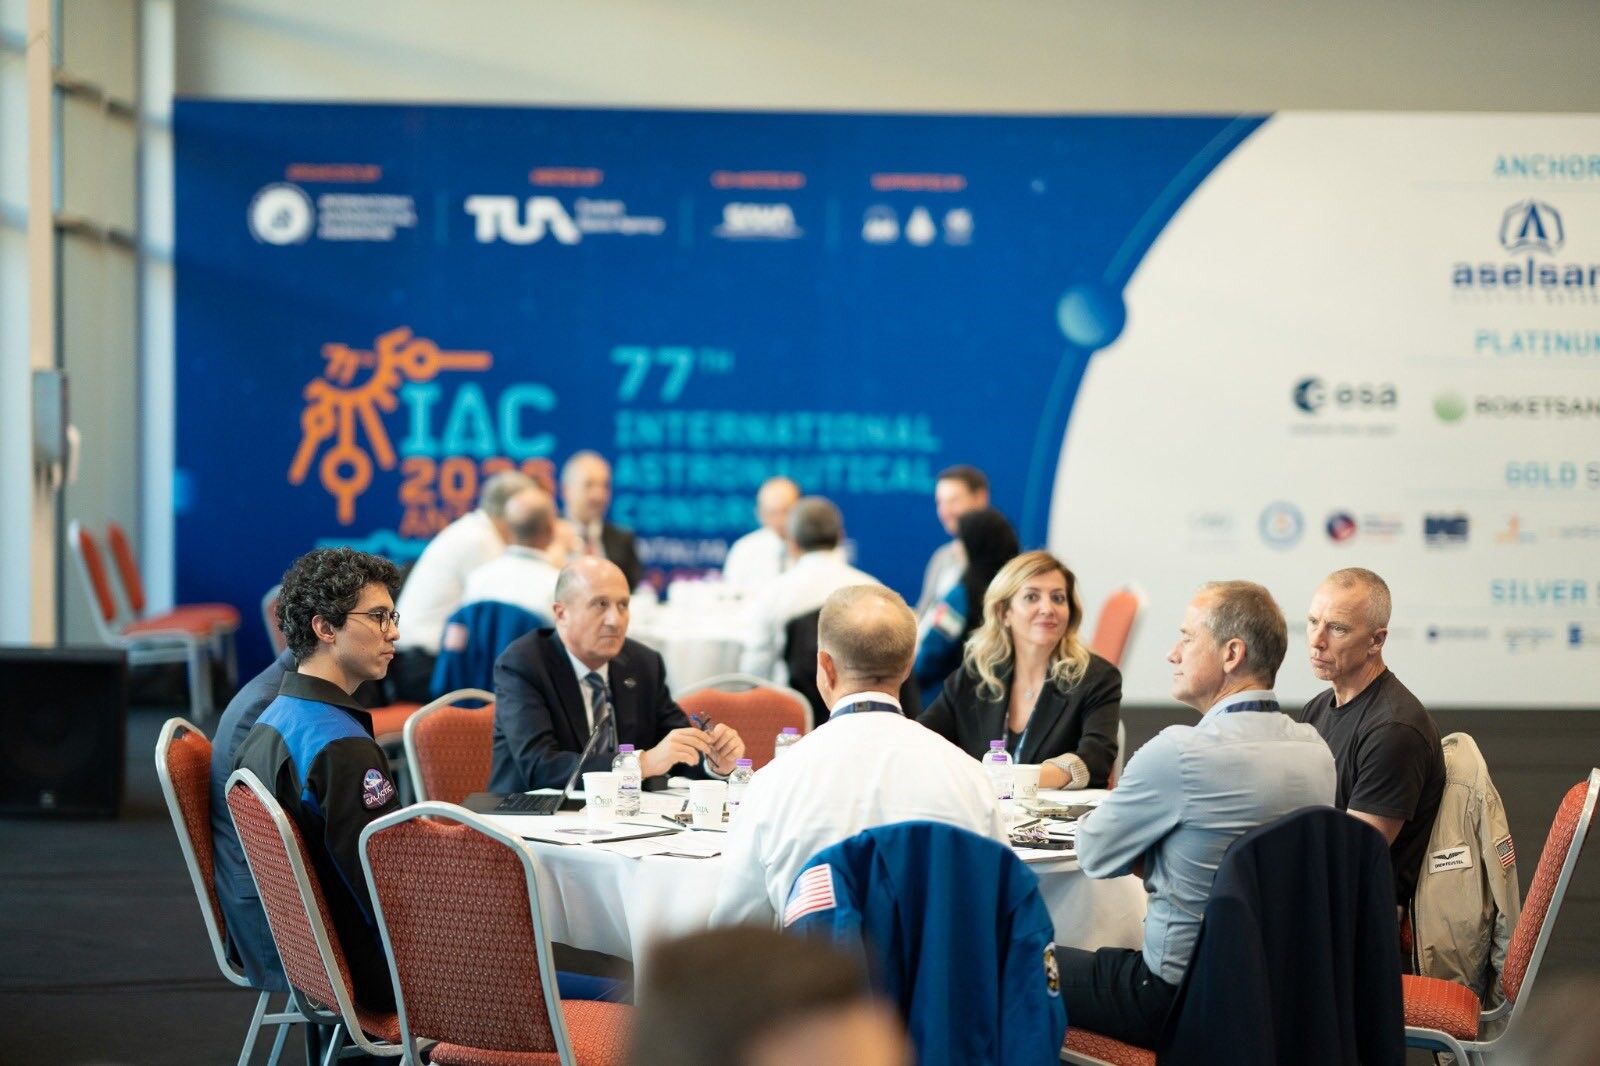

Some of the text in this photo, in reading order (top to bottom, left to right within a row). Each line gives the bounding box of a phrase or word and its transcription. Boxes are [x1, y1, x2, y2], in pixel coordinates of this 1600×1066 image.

[401, 383, 557, 455] IAC
[614, 410, 940, 452] INTERNATIONAL
[1504, 462, 1577, 490] GOLD
[1491, 580, 1588, 606] SILVER
